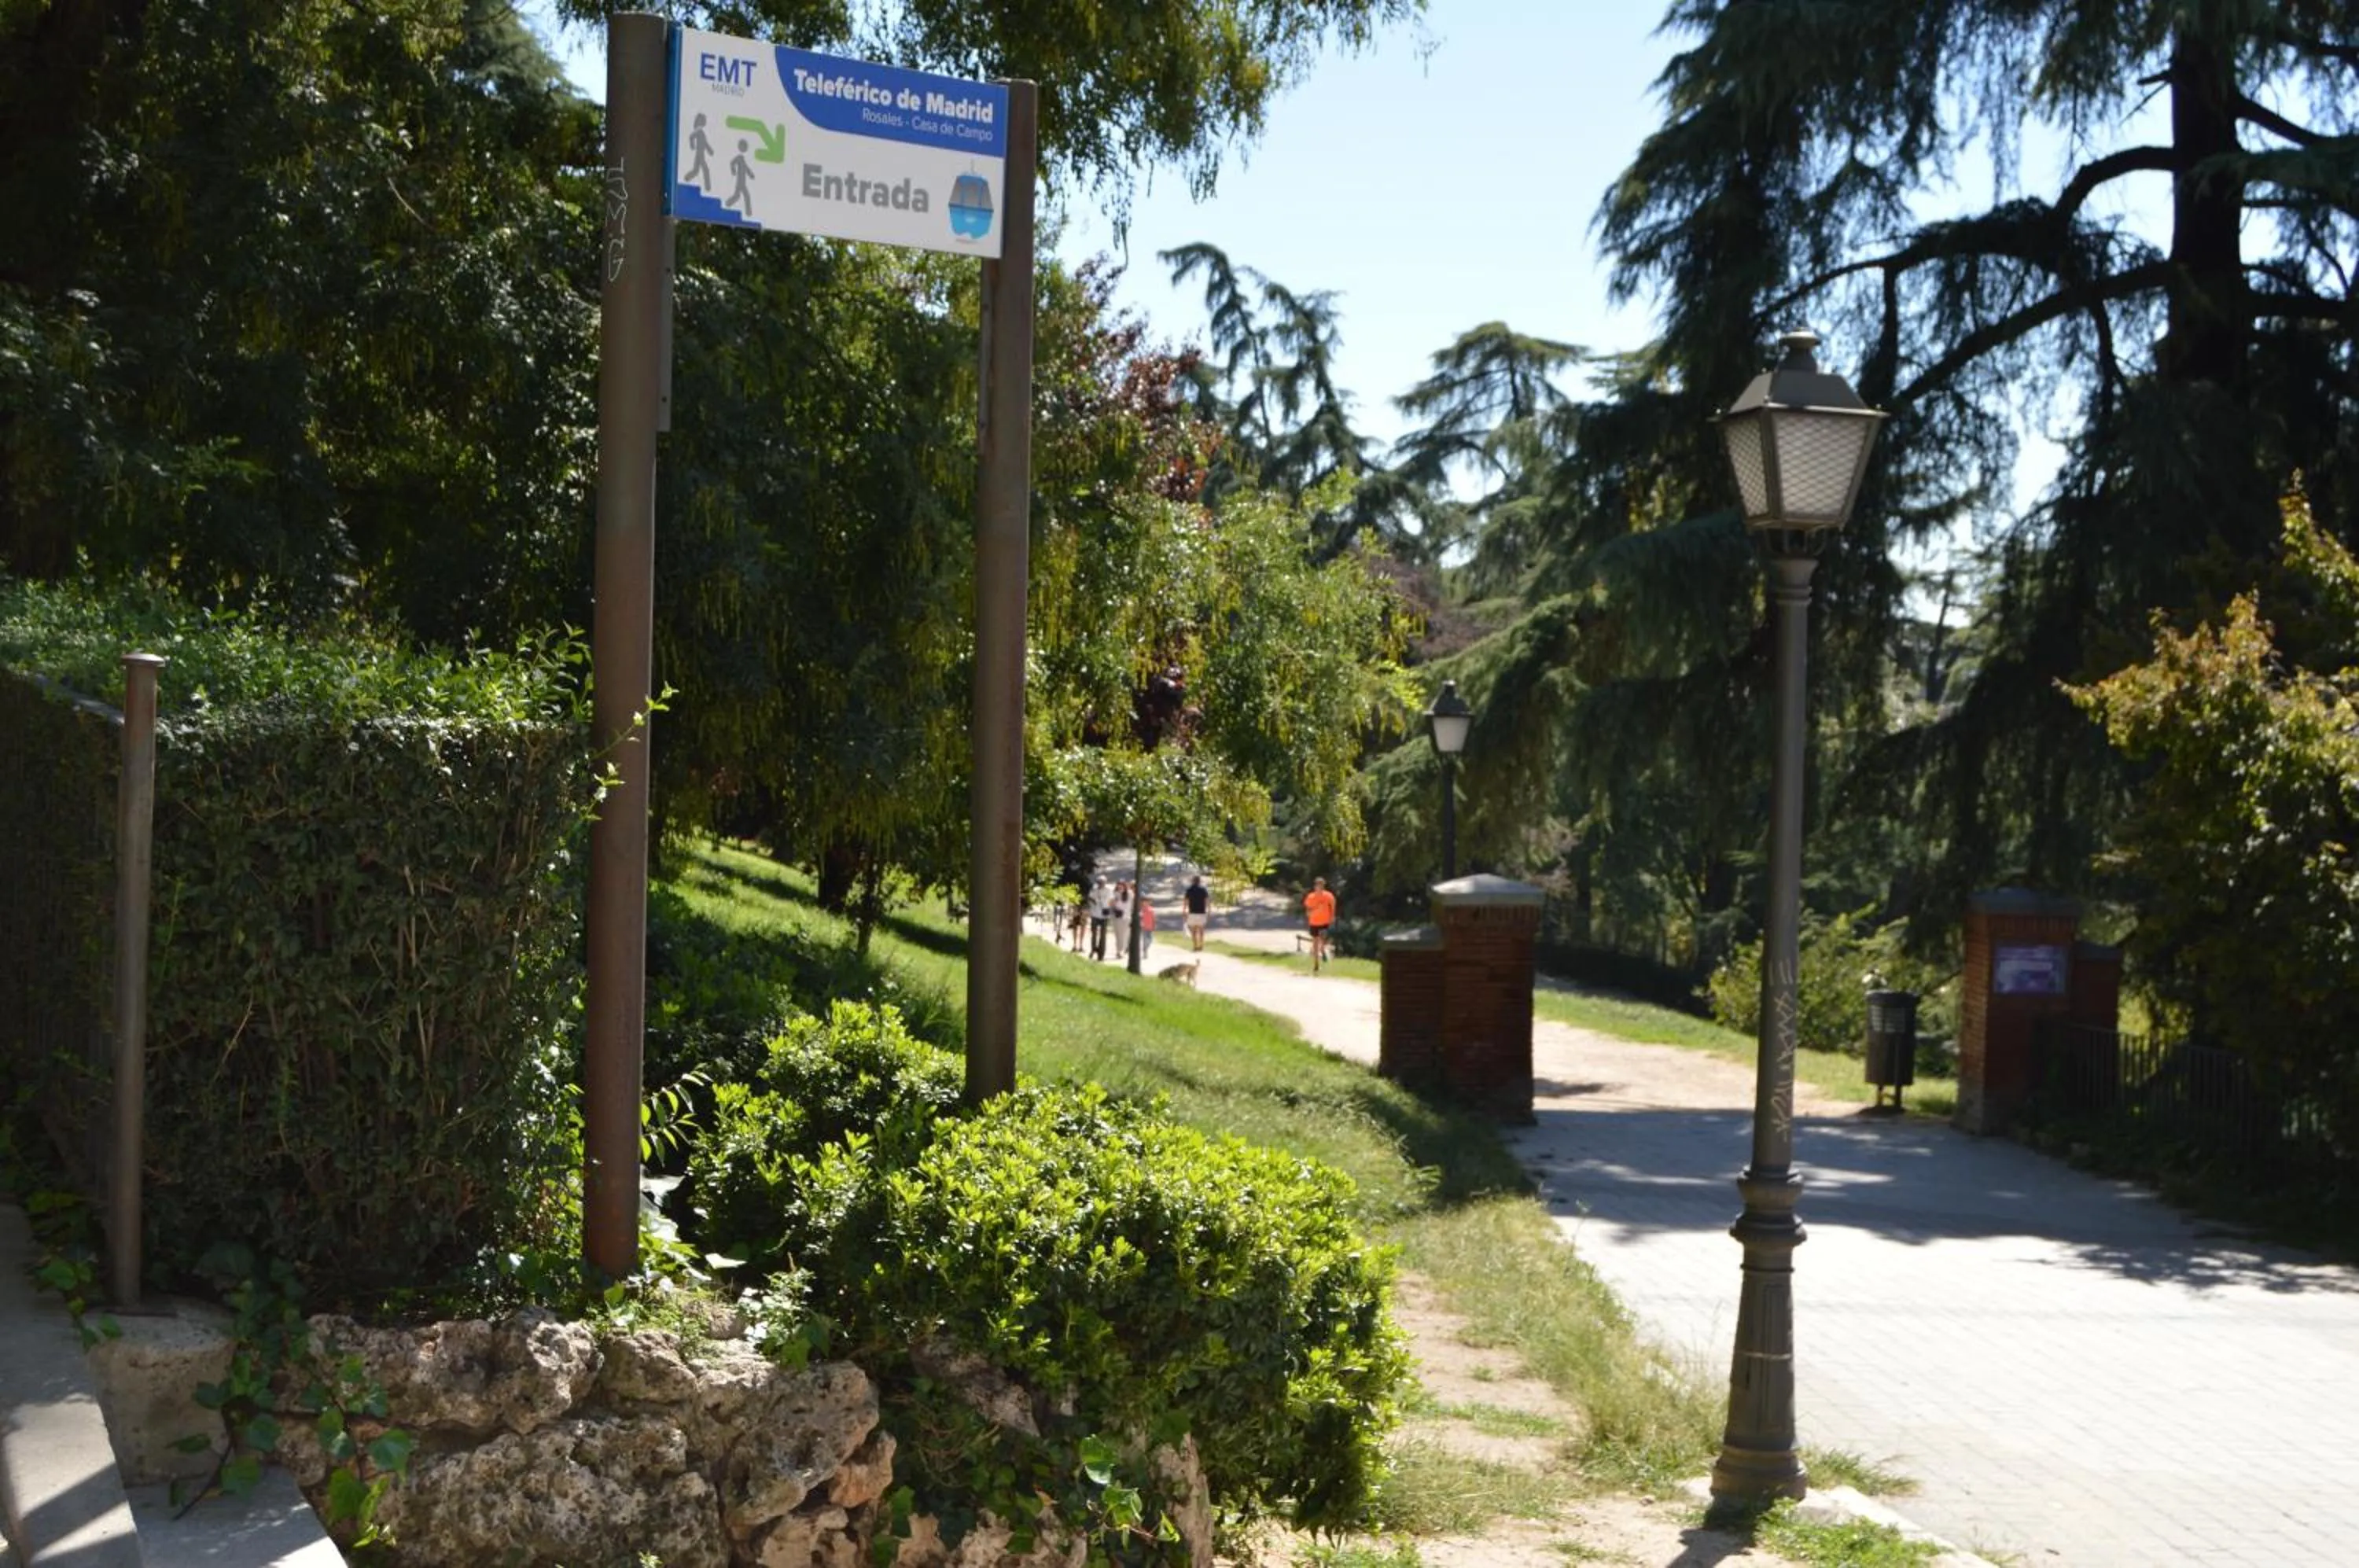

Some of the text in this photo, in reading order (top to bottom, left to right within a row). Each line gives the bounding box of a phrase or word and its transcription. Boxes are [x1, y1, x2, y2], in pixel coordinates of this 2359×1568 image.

[701, 52, 757, 87] EMT
[793, 68, 993, 123] Teleférico de Madrid
[863, 107, 903, 126] Rosales
[912, 116, 938, 133] Casa
[940, 122, 954, 134] de
[956, 123, 993, 142] Campo
[802, 163, 929, 213] Entrada
